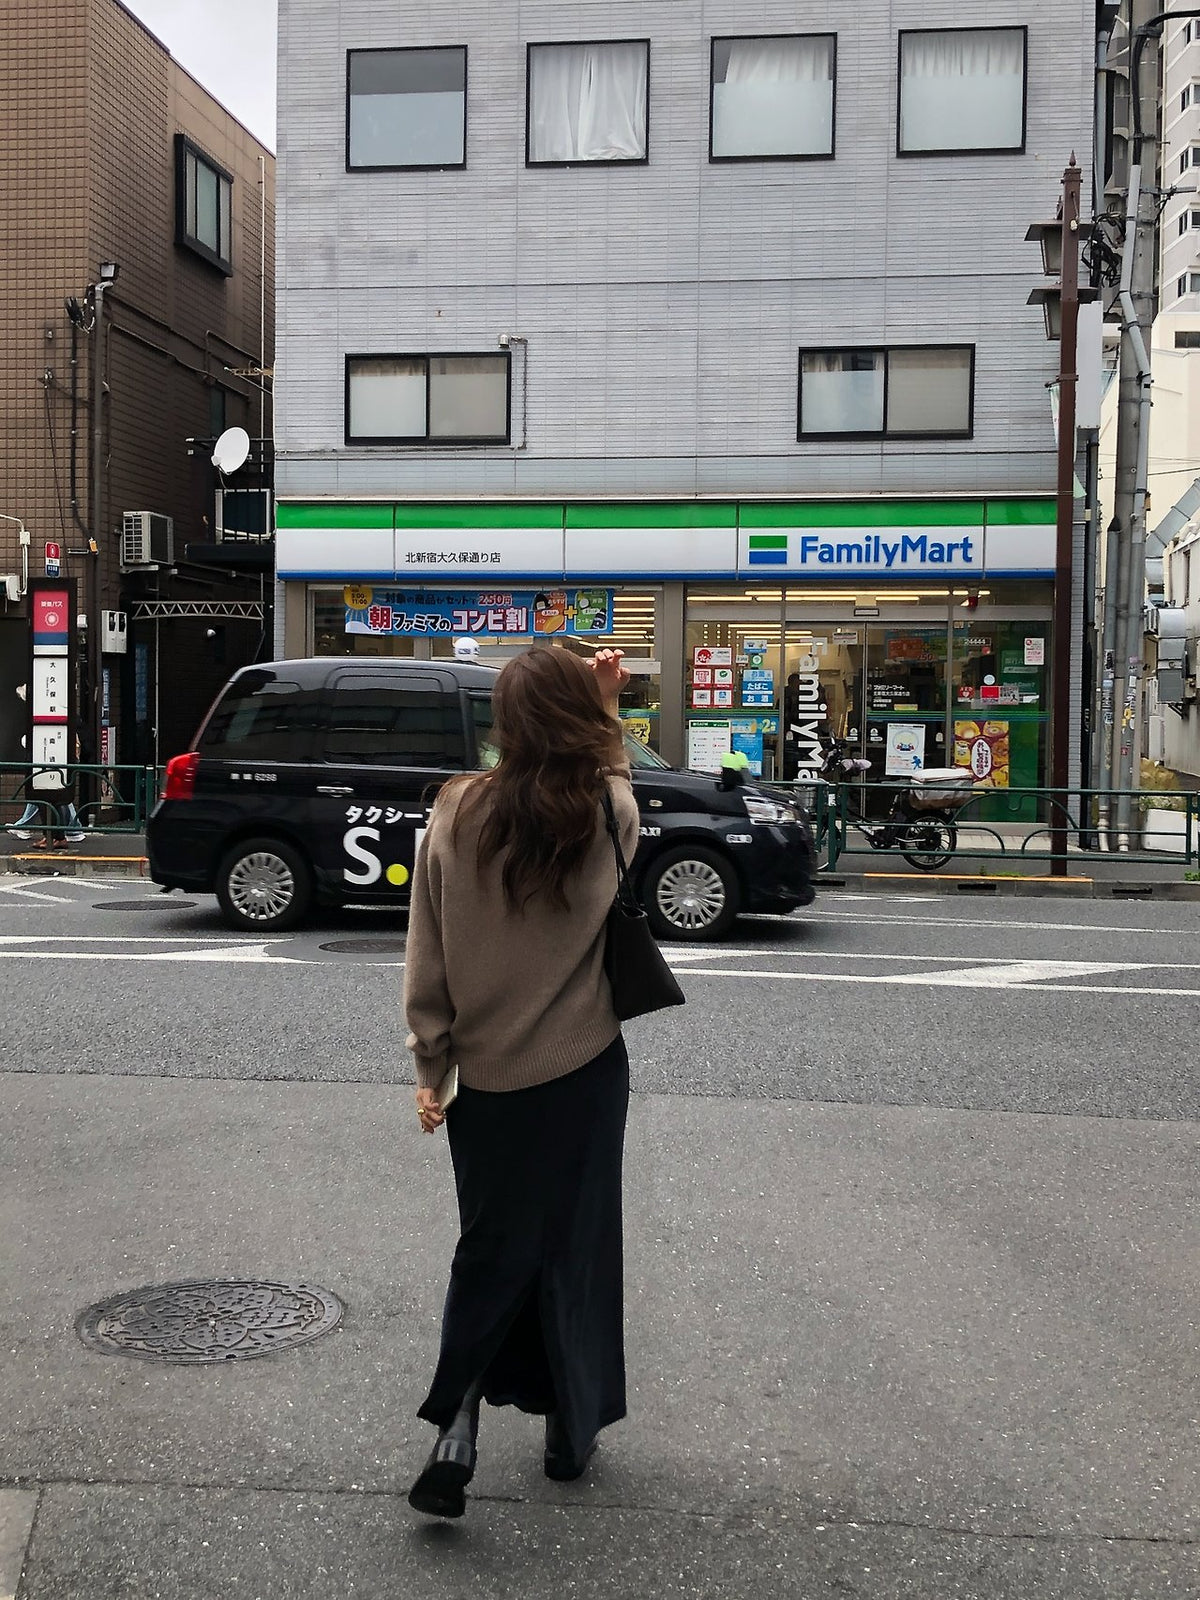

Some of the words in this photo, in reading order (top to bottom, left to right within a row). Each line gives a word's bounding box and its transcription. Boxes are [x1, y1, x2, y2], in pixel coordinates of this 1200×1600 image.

[405, 552, 501, 563] 北新宿大久保通り店
[801, 534, 973, 567] FamilyMart
[368, 605, 528, 632] 朝ファミマのコンビ割
[747, 682, 769, 691] たばこ
[343, 826, 426, 886] S.
